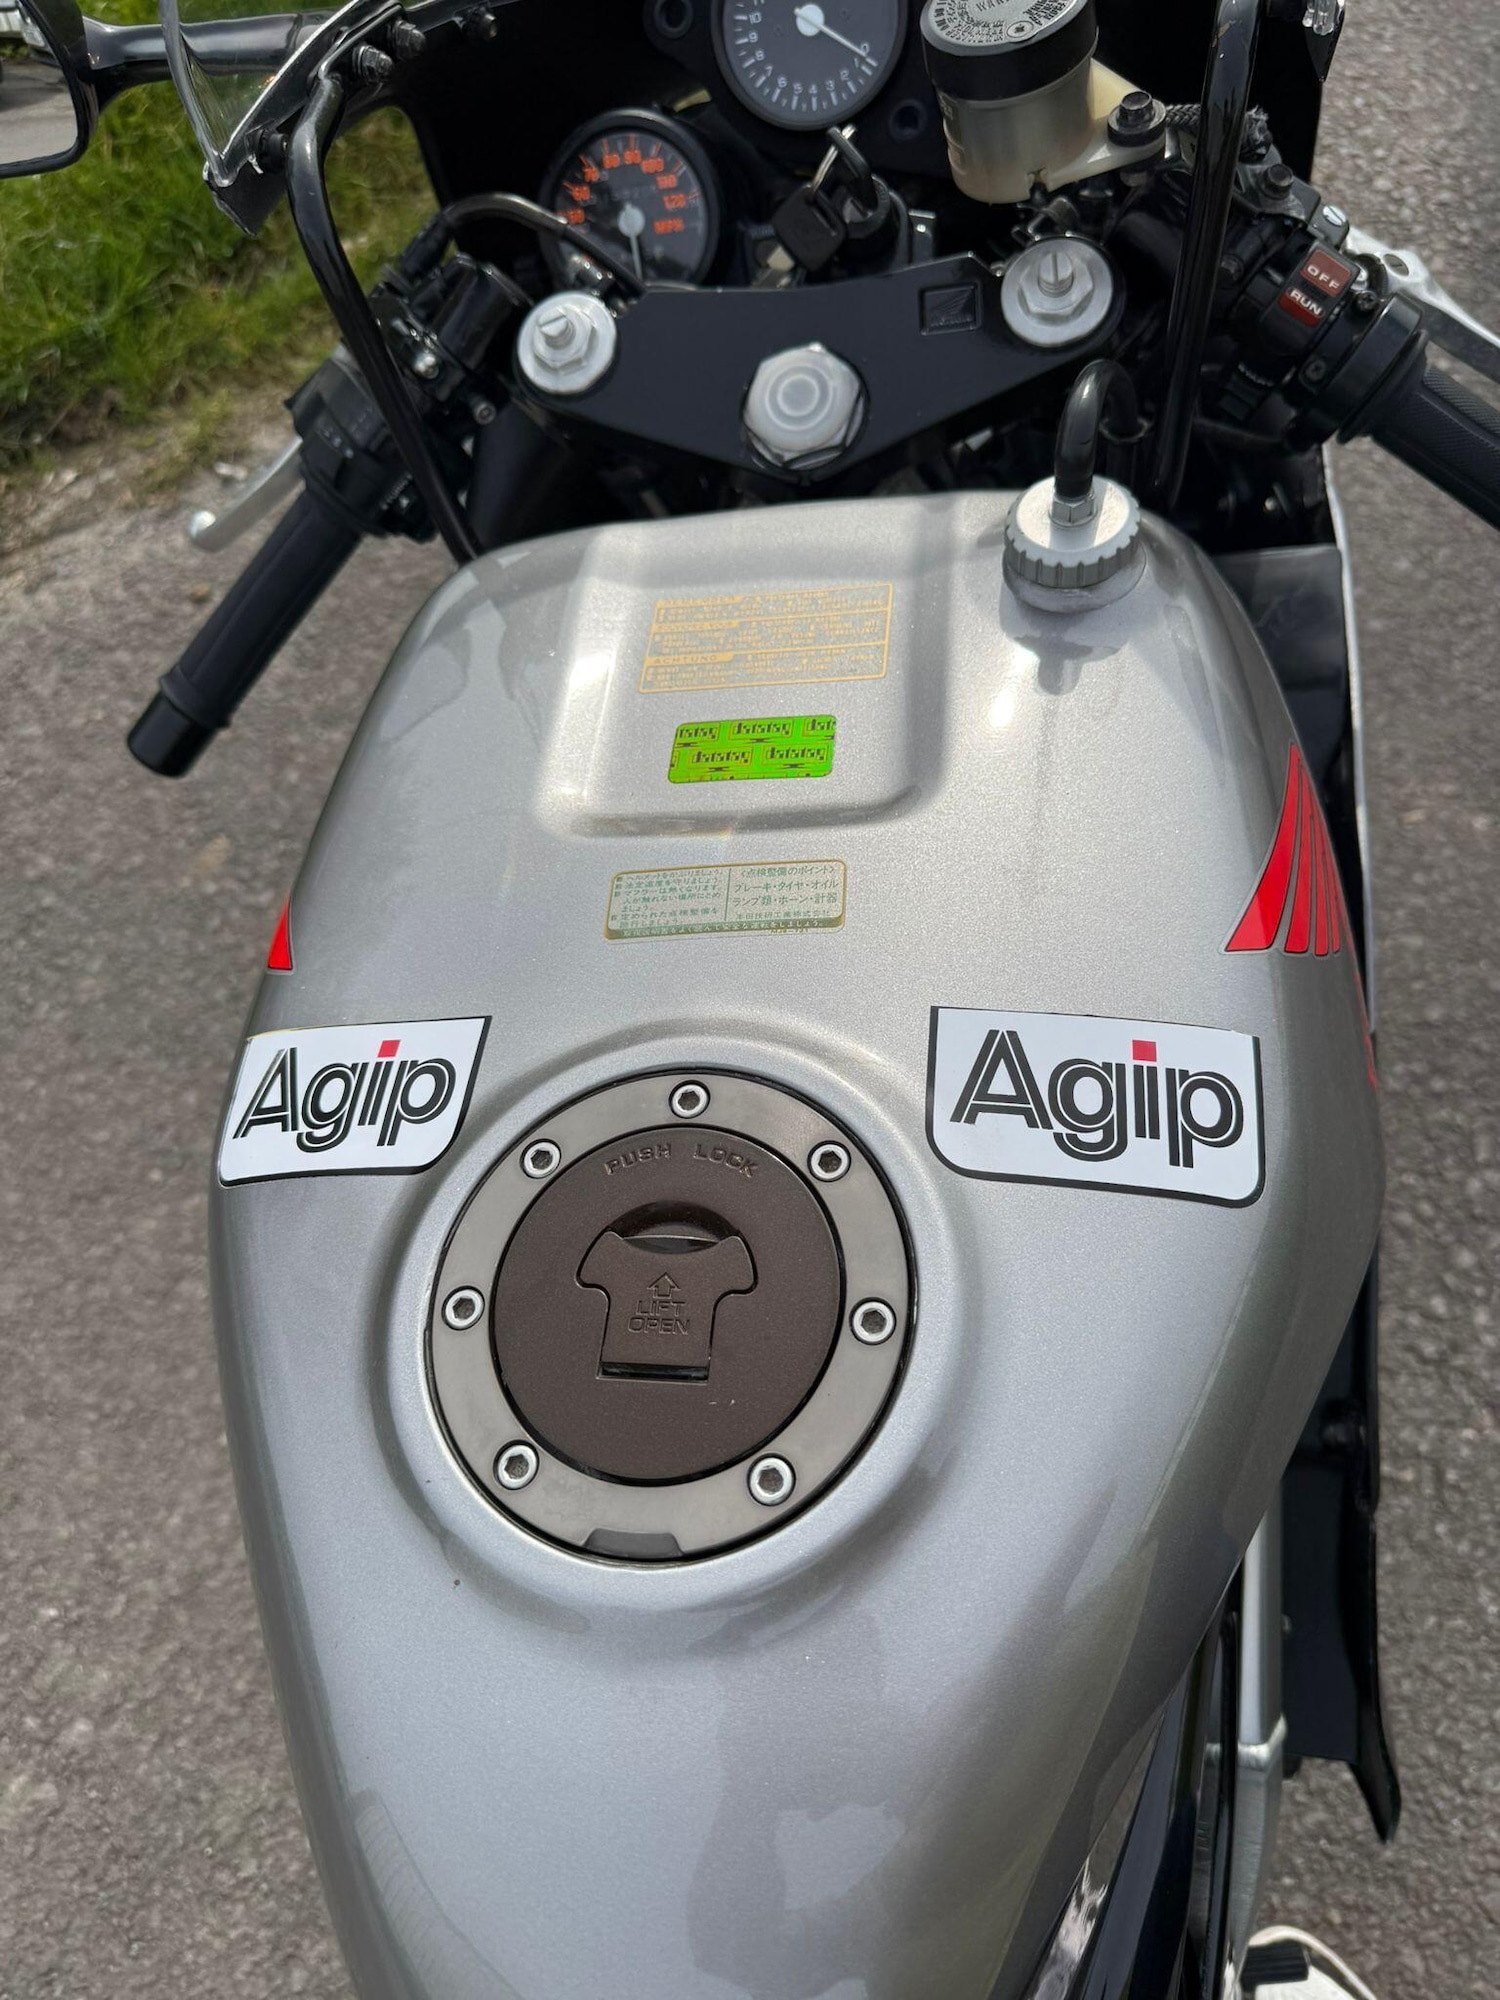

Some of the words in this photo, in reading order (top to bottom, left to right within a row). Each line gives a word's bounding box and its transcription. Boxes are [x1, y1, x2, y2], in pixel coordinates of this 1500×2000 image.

[749, 12, 762, 24] 10
[749, 32, 758, 44] 9
[860, 43, 870, 55] 0
[755, 51, 765, 61] 8
[854, 58, 860, 68] 1
[764, 65, 773, 76] 7
[840, 69, 850, 81] 2
[777, 77, 788, 88] 6
[793, 83, 802, 94] 5
[825, 80, 835, 91] 3
[808, 84, 817, 95] 4
[1306, 264, 1341, 291] OFF
[1289, 288, 1323, 316] RUN
[733, 876, 839, 894] ブレーキ・タイヤ・オイル
[232, 1039, 456, 1153] Agip
[950, 1029, 1244, 1168] Agip
[604, 1142, 671, 1176] PUSH
[693, 1143, 759, 1178] LOCK
[635, 1299, 686, 1317] LIFT
[627, 1317, 691, 1336] OPEN
